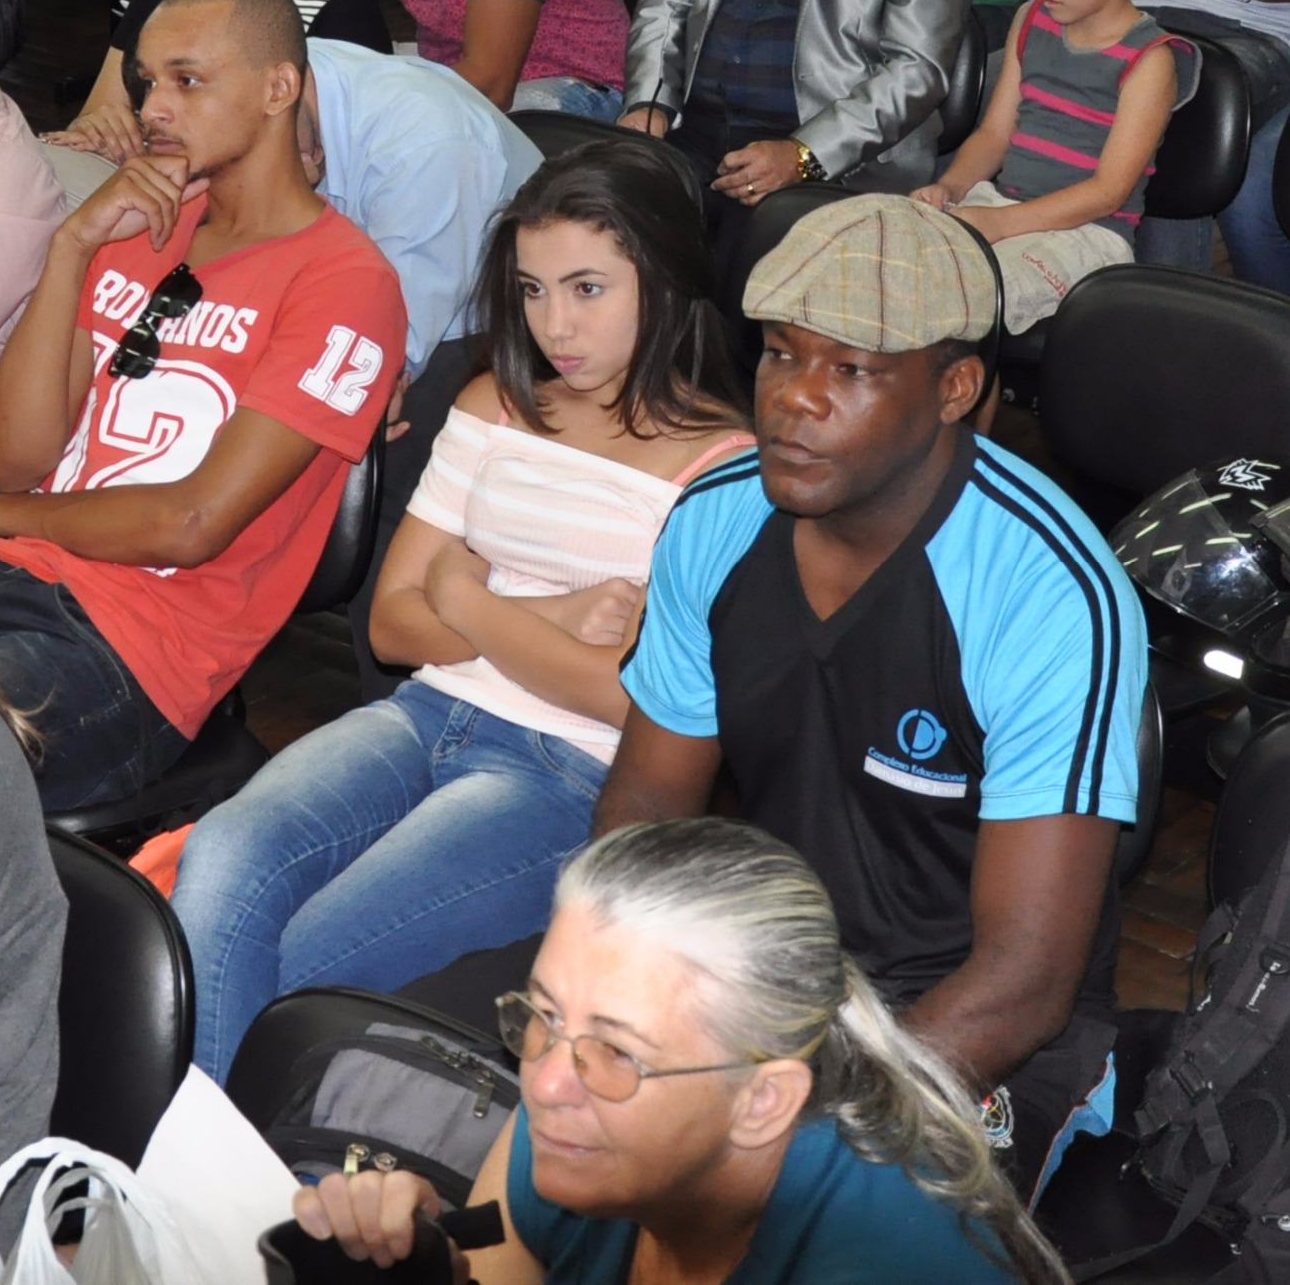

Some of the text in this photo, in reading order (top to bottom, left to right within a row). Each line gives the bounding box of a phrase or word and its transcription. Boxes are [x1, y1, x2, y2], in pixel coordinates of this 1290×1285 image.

[297, 324, 384, 417] 12
[867, 747, 967, 783] Complexo Educacional
